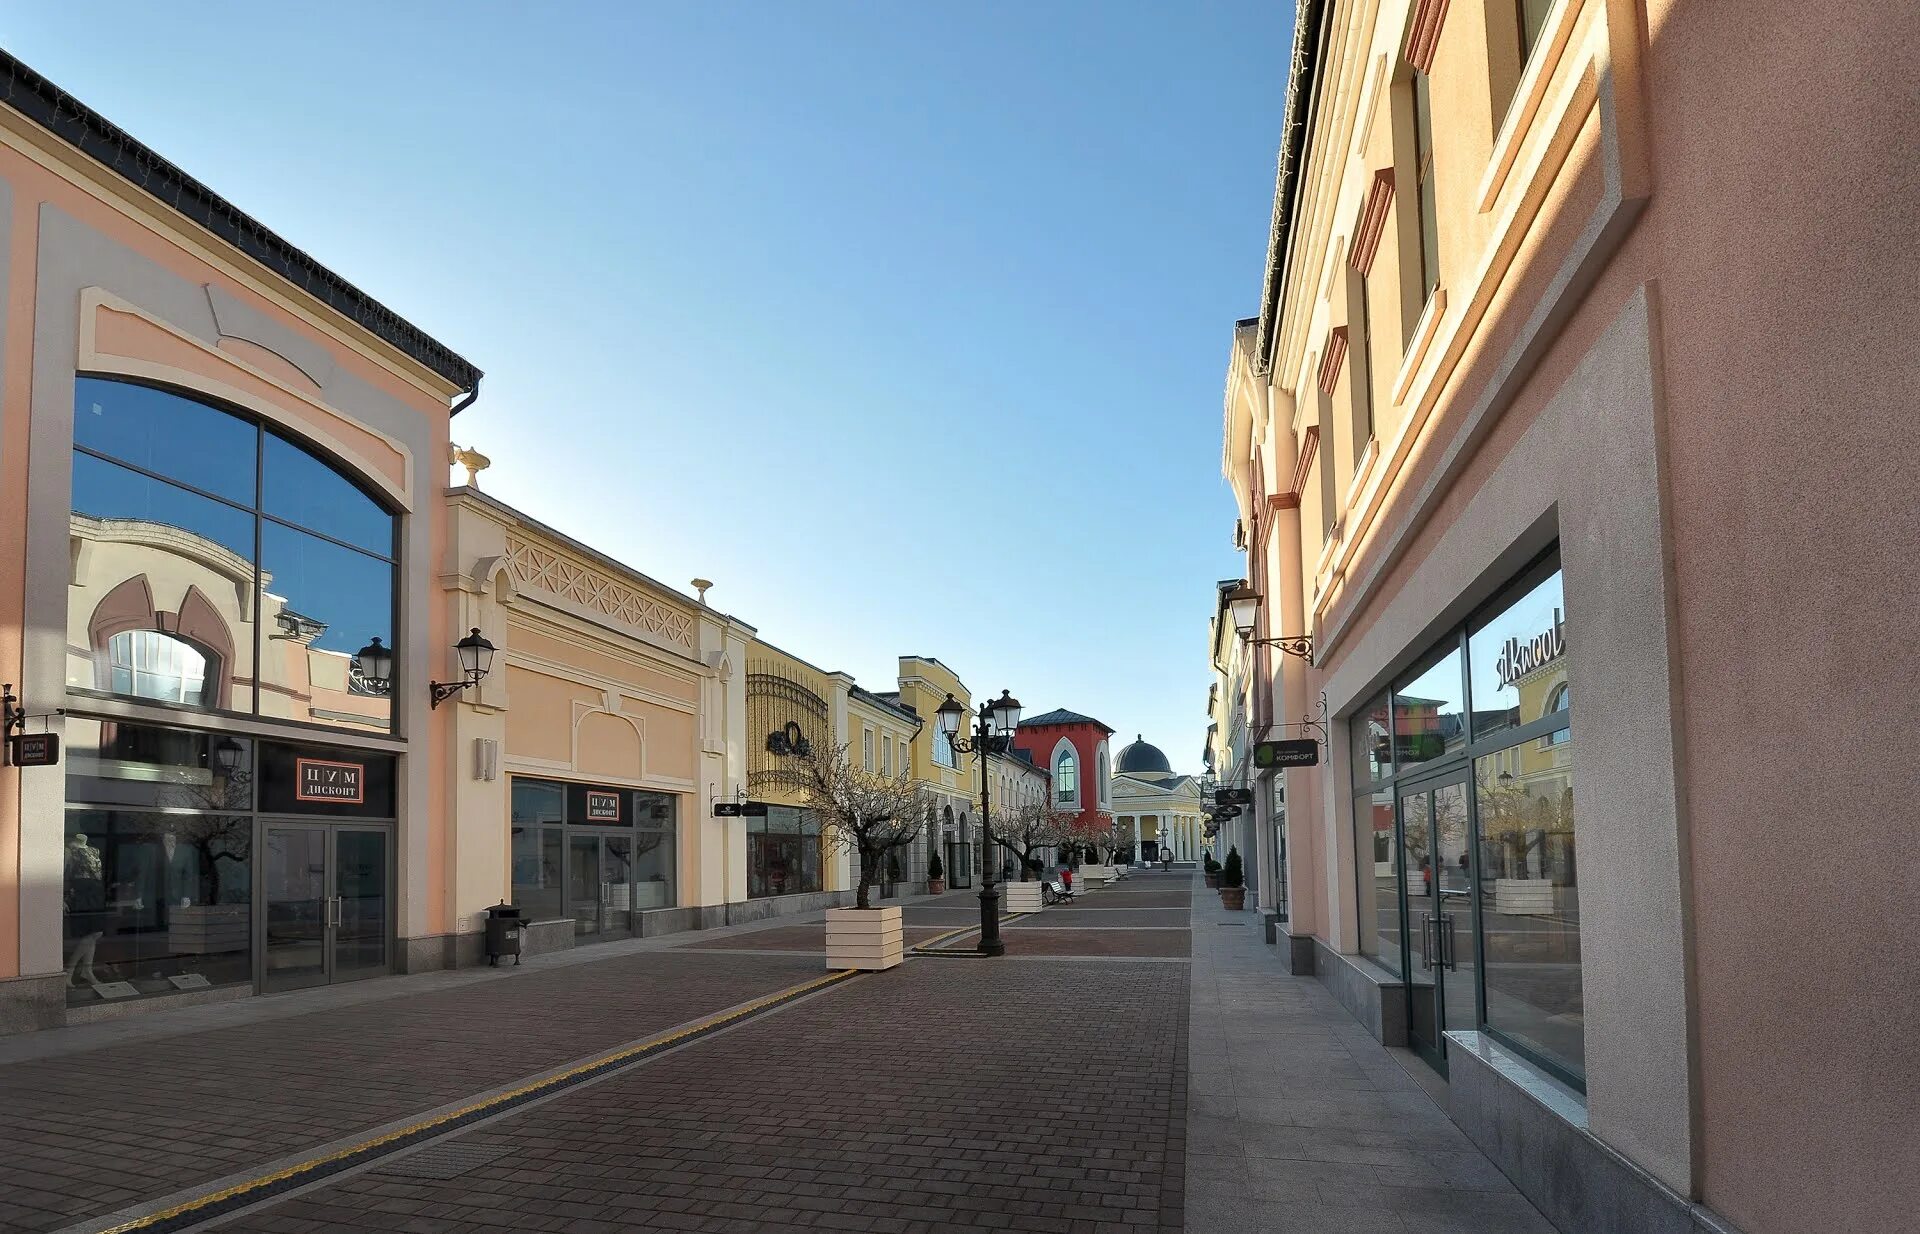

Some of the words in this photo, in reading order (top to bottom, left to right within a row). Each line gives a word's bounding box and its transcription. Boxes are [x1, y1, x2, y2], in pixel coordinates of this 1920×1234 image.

[1496, 607, 1567, 692] silkwool
[1276, 753, 1314, 761] КОМФОРТ
[306, 785, 356, 796] ДИСКОНТ
[592, 808, 615, 816] ДИСКОНТ
